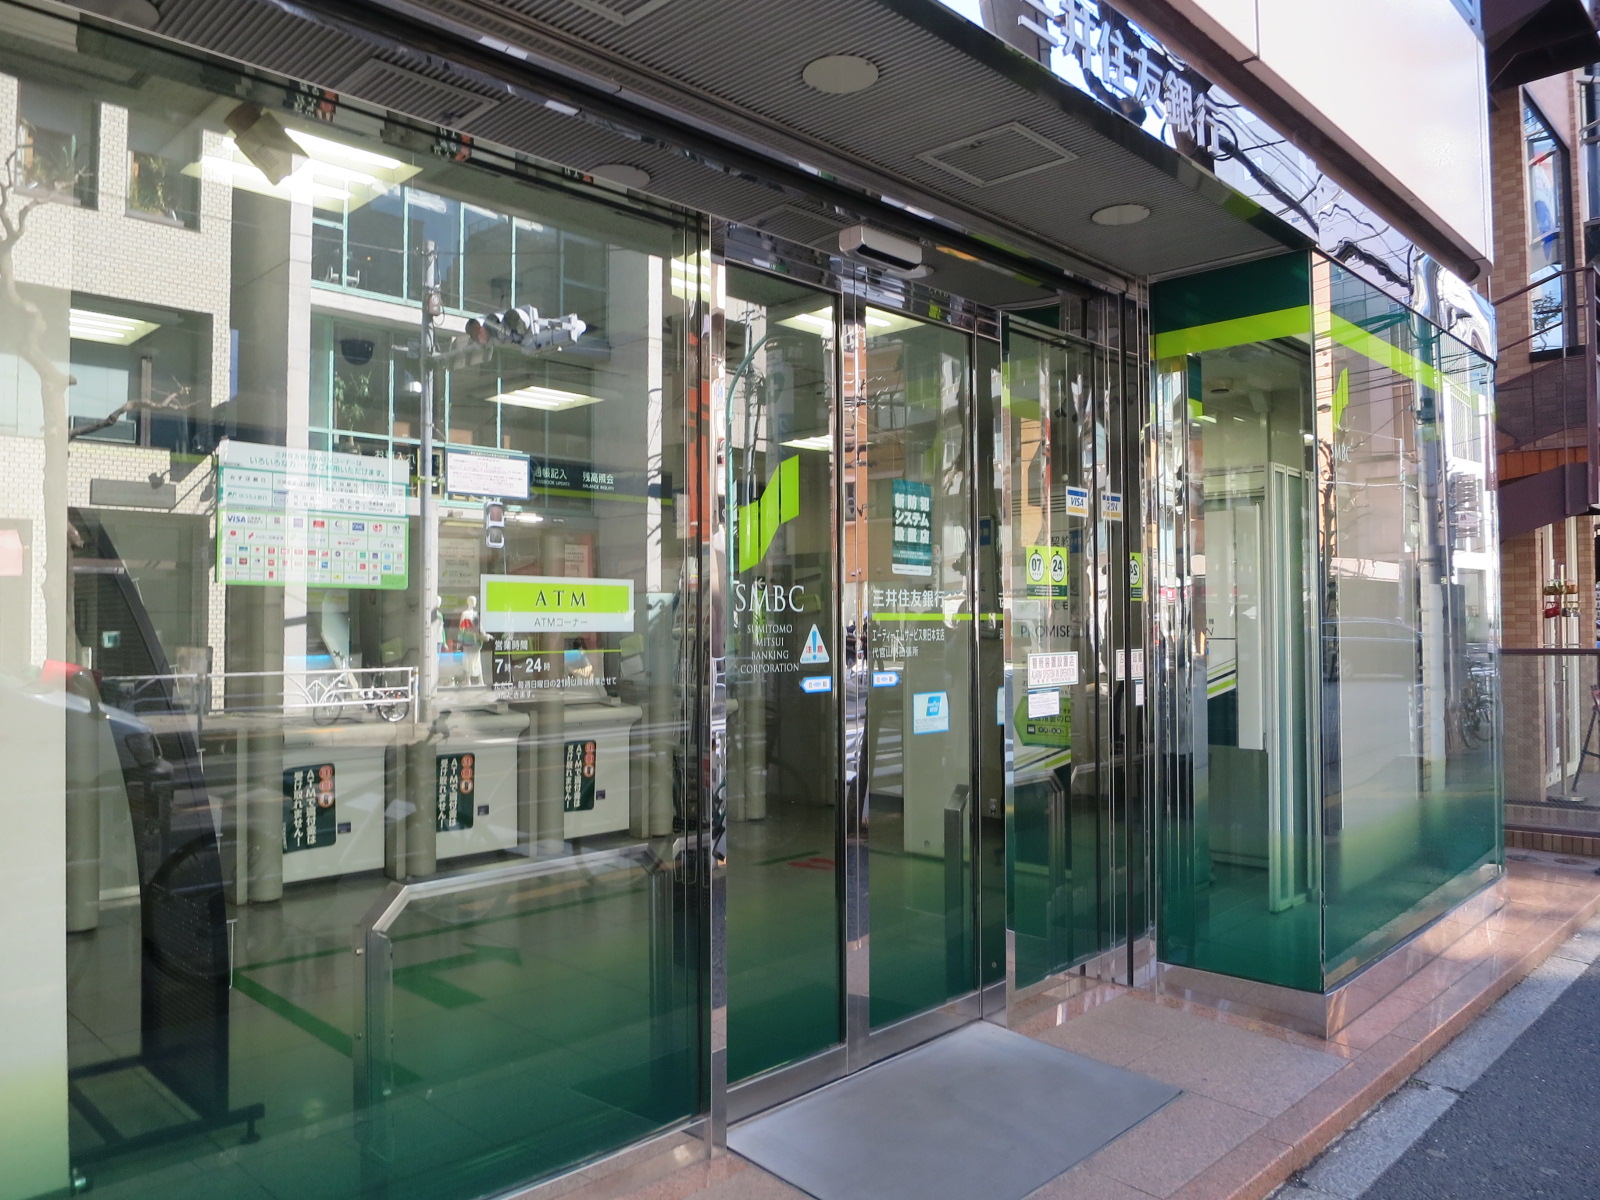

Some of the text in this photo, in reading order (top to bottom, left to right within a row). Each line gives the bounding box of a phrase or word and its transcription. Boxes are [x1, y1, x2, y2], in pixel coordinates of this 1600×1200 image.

[1018, 0, 1220, 152] 三井住友銀行
[582, 471, 614, 484] 残高照会
[894, 493, 930, 511] 新防犯
[1070, 497, 1084, 507] VISA
[227, 515, 246, 523] VISA
[894, 509, 930, 528] システム
[1031, 558, 1042, 571] 07
[1052, 559, 1063, 572] 24
[535, 590, 586, 607] ATM
[735, 583, 805, 613] SMBC
[872, 588, 946, 608] 三井住友銀行
[534, 618, 588, 627] ATMコーナー
[747, 624, 793, 634] SUMITOMO
[494, 640, 529, 651] 営業時間
[755, 637, 784, 647] MITSUI
[751, 650, 789, 660] BANKING
[740, 663, 800, 674] CORPORATION
